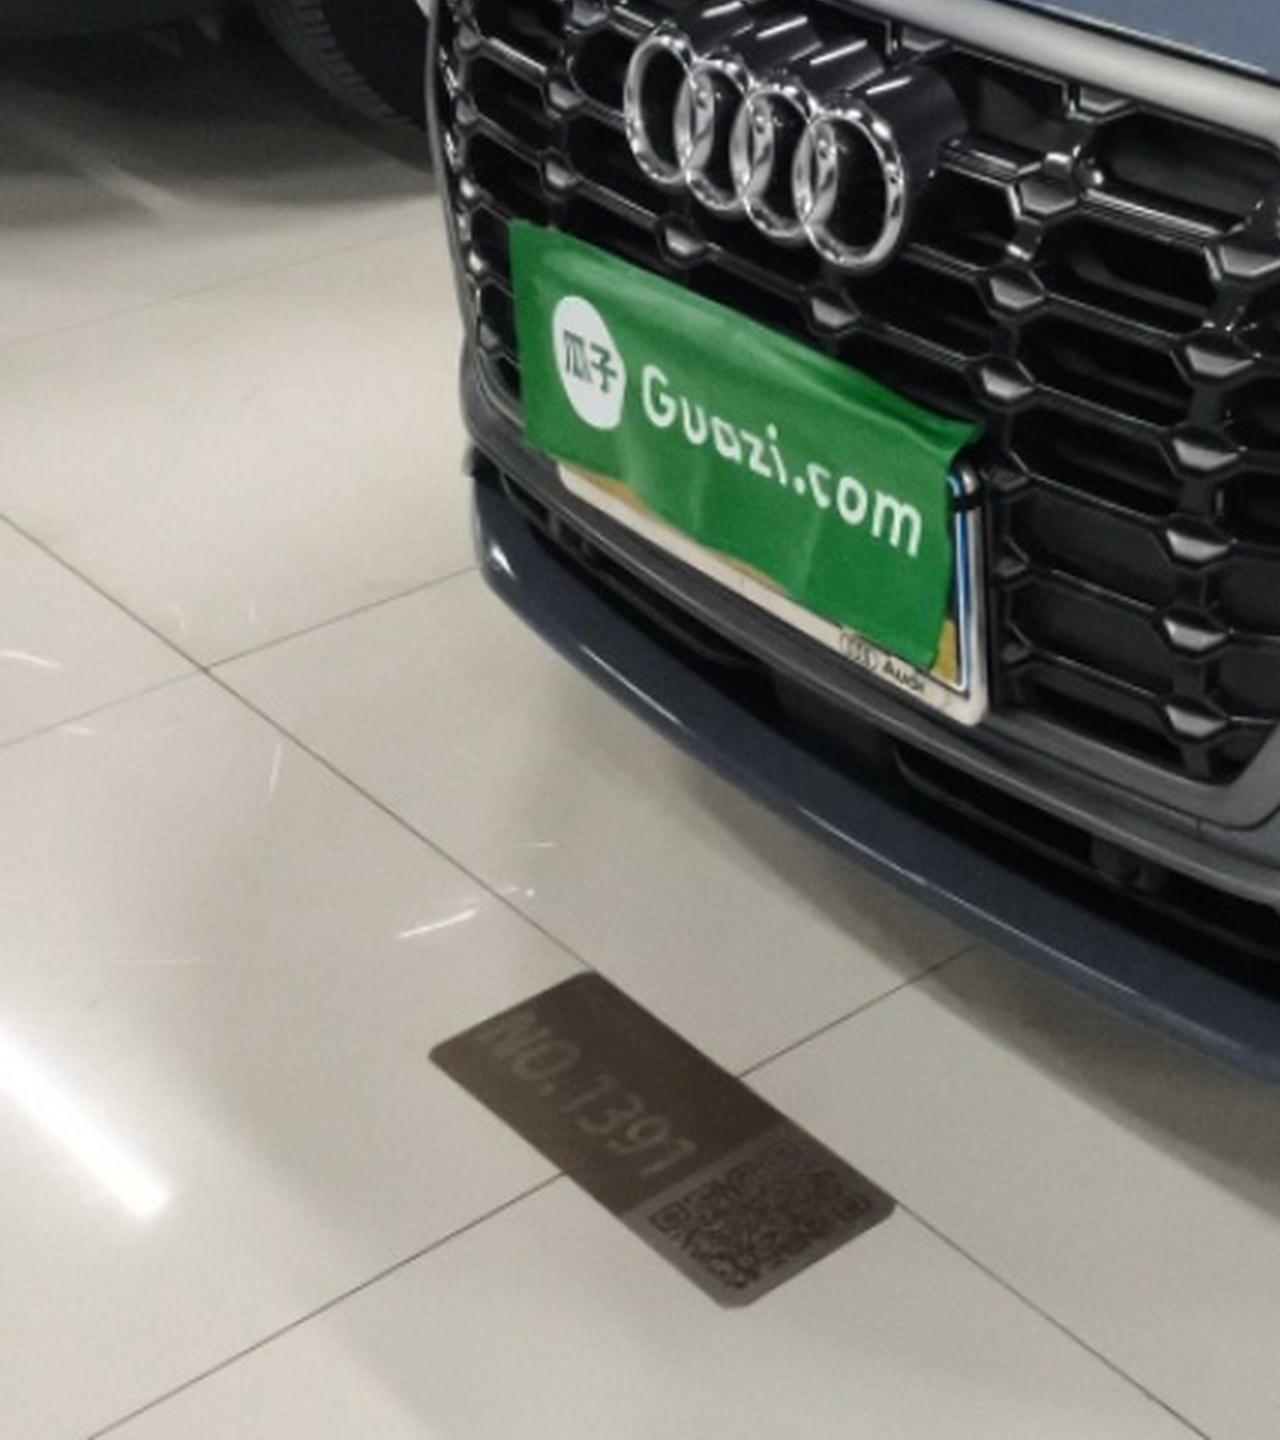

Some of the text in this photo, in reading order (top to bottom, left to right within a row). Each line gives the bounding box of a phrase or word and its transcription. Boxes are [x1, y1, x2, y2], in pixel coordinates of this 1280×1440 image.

[563, 329, 618, 394] 瓜子
[642, 364, 922, 558] Guazi.com
[882, 658, 925, 694] Audi
